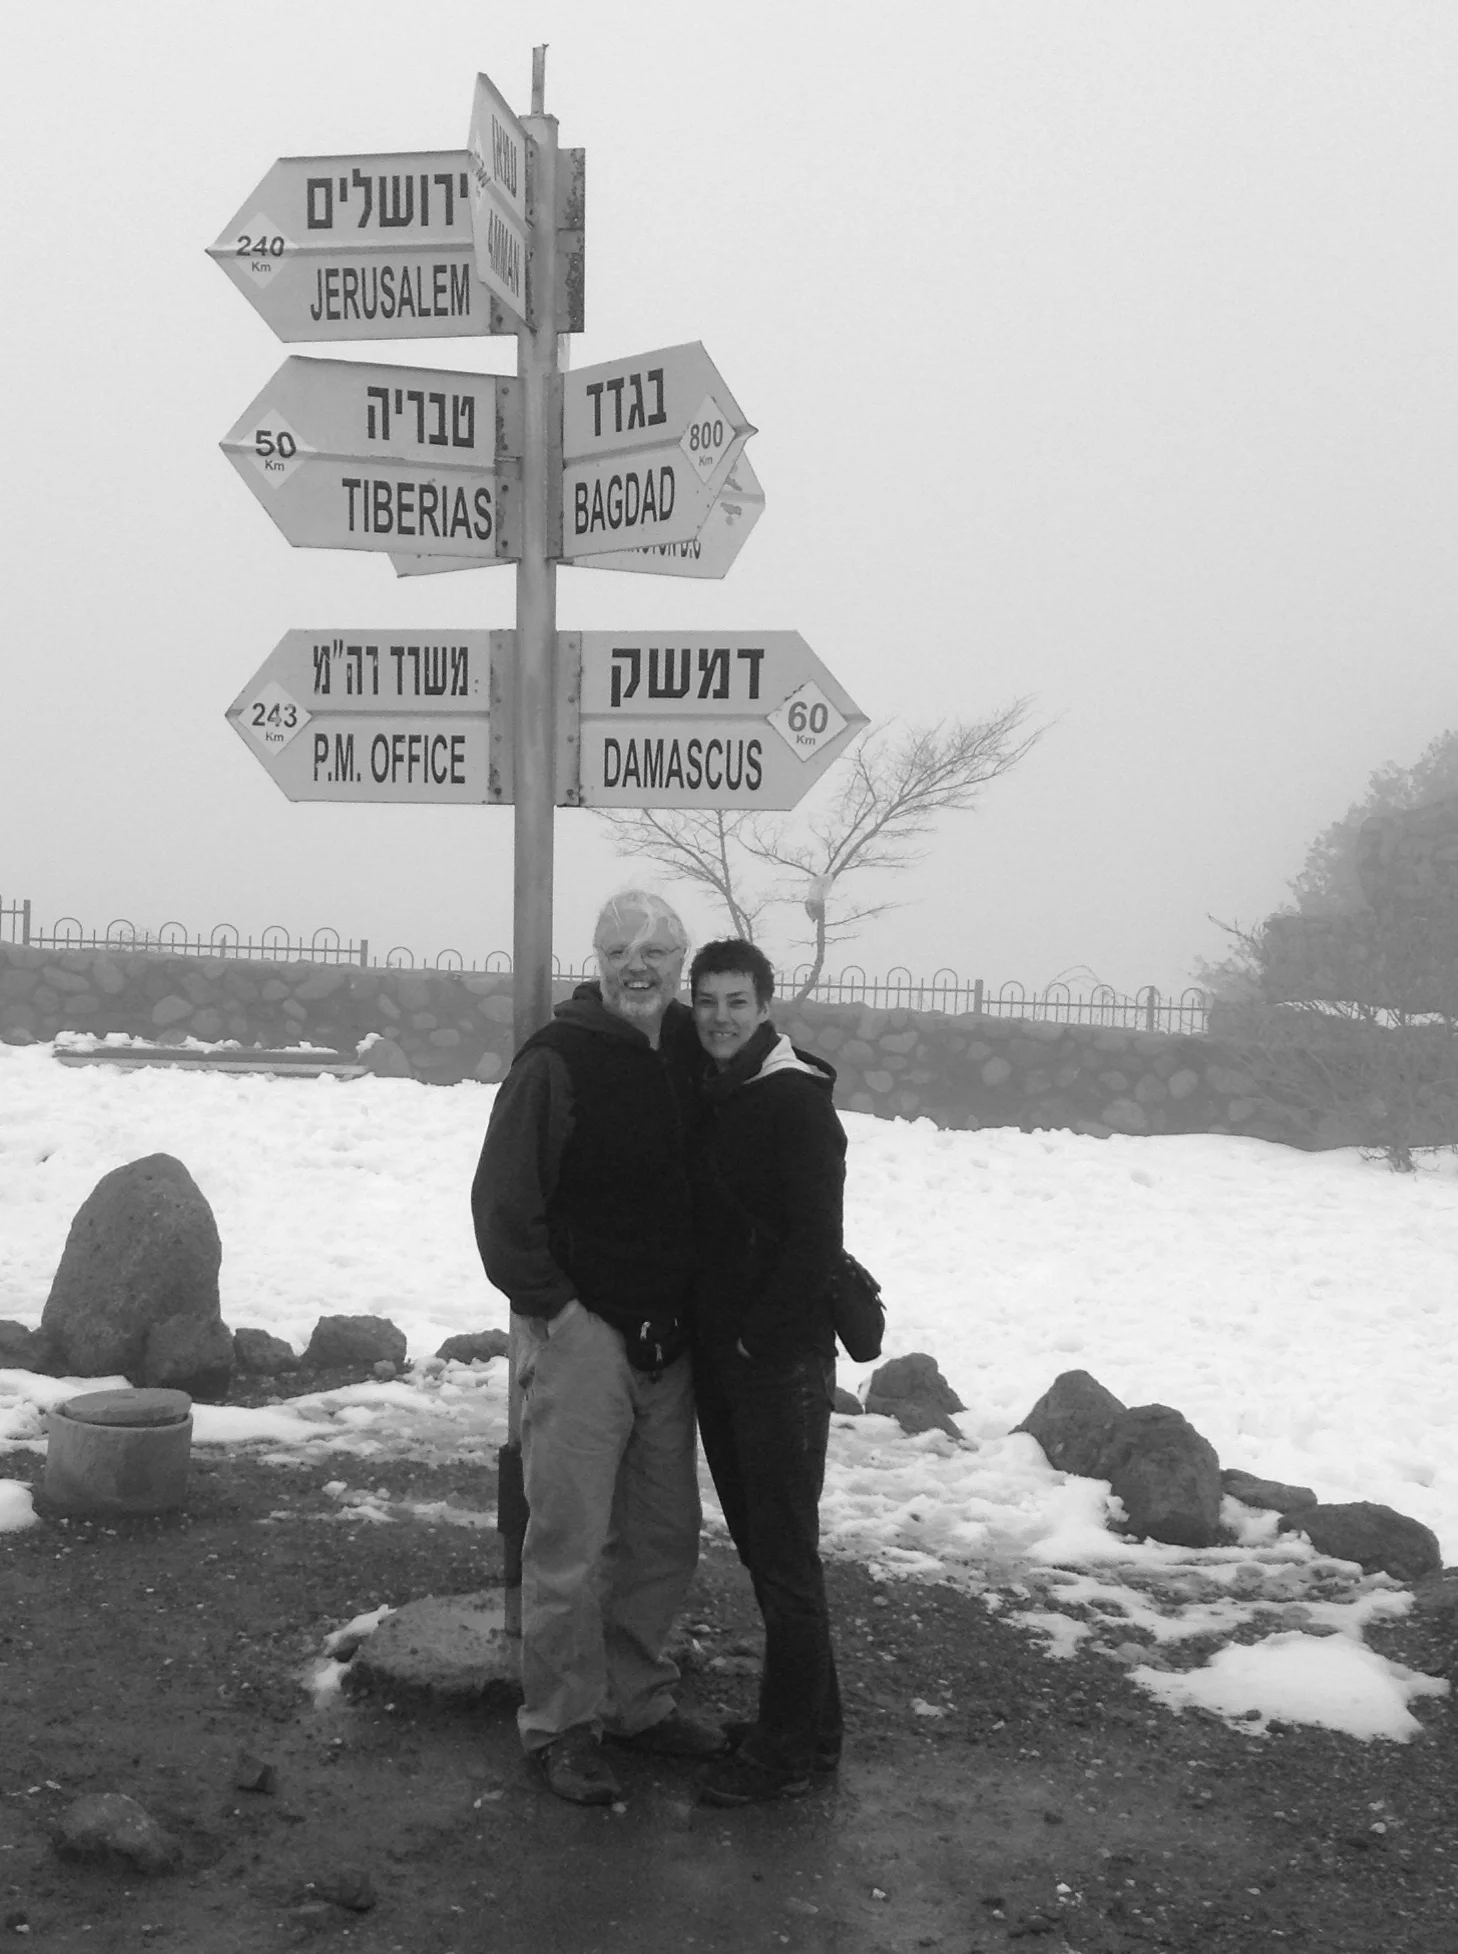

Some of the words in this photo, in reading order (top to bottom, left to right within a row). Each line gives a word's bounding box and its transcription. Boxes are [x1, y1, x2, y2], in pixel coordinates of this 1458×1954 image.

[307, 168, 468, 229] ירושלים
[235, 235, 285, 257] 240
[251, 261, 272, 273] Km
[310, 263, 470, 321] JERUSALEM
[367, 386, 475, 449] טבריה
[586, 368, 667, 437] בגדד
[255, 430, 296, 458] 50
[689, 420, 724, 451] 800
[265, 459, 285, 472] Km
[699, 455, 713, 467] Km
[342, 477, 493, 541] TIBERIAS
[575, 465, 675, 535] BAGDAD
[390, 646, 468, 696] משרד
[610, 648, 765, 708] דמשק
[252, 702, 297, 728] 243
[788, 701, 829, 734] 60
[265, 731, 284, 743] Km
[796, 734, 816, 746] Km
[313, 733, 361, 782] P.M.
[370, 733, 466, 784] OFFICE
[603, 738, 762, 791] DAMASCUS
